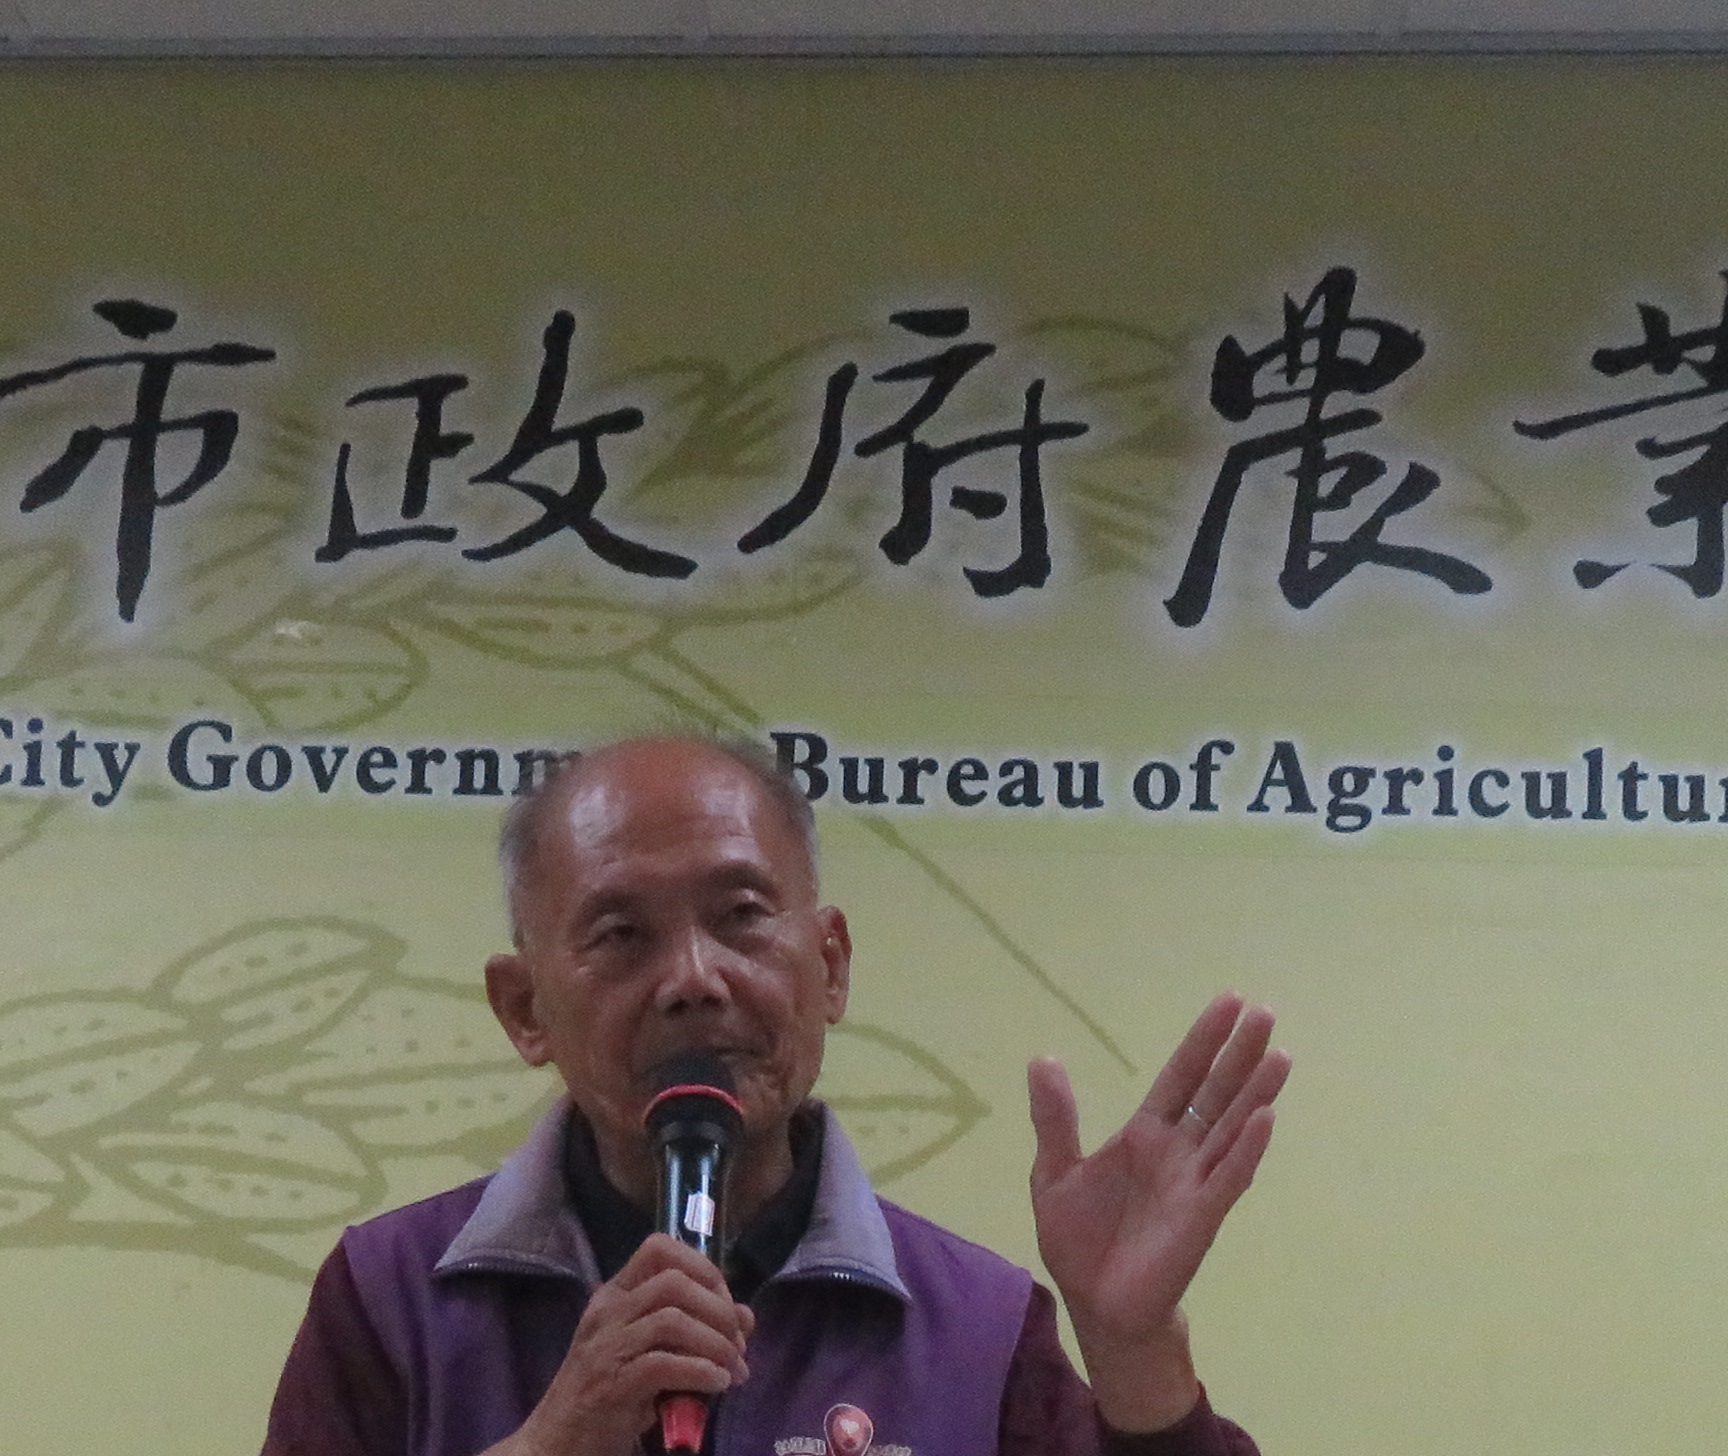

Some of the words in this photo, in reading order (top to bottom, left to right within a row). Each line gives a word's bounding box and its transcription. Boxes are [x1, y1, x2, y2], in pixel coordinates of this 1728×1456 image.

[168, 720, 584, 796] Governm
[770, 731, 1103, 812] Bureau
[1133, 740, 1238, 815] of
